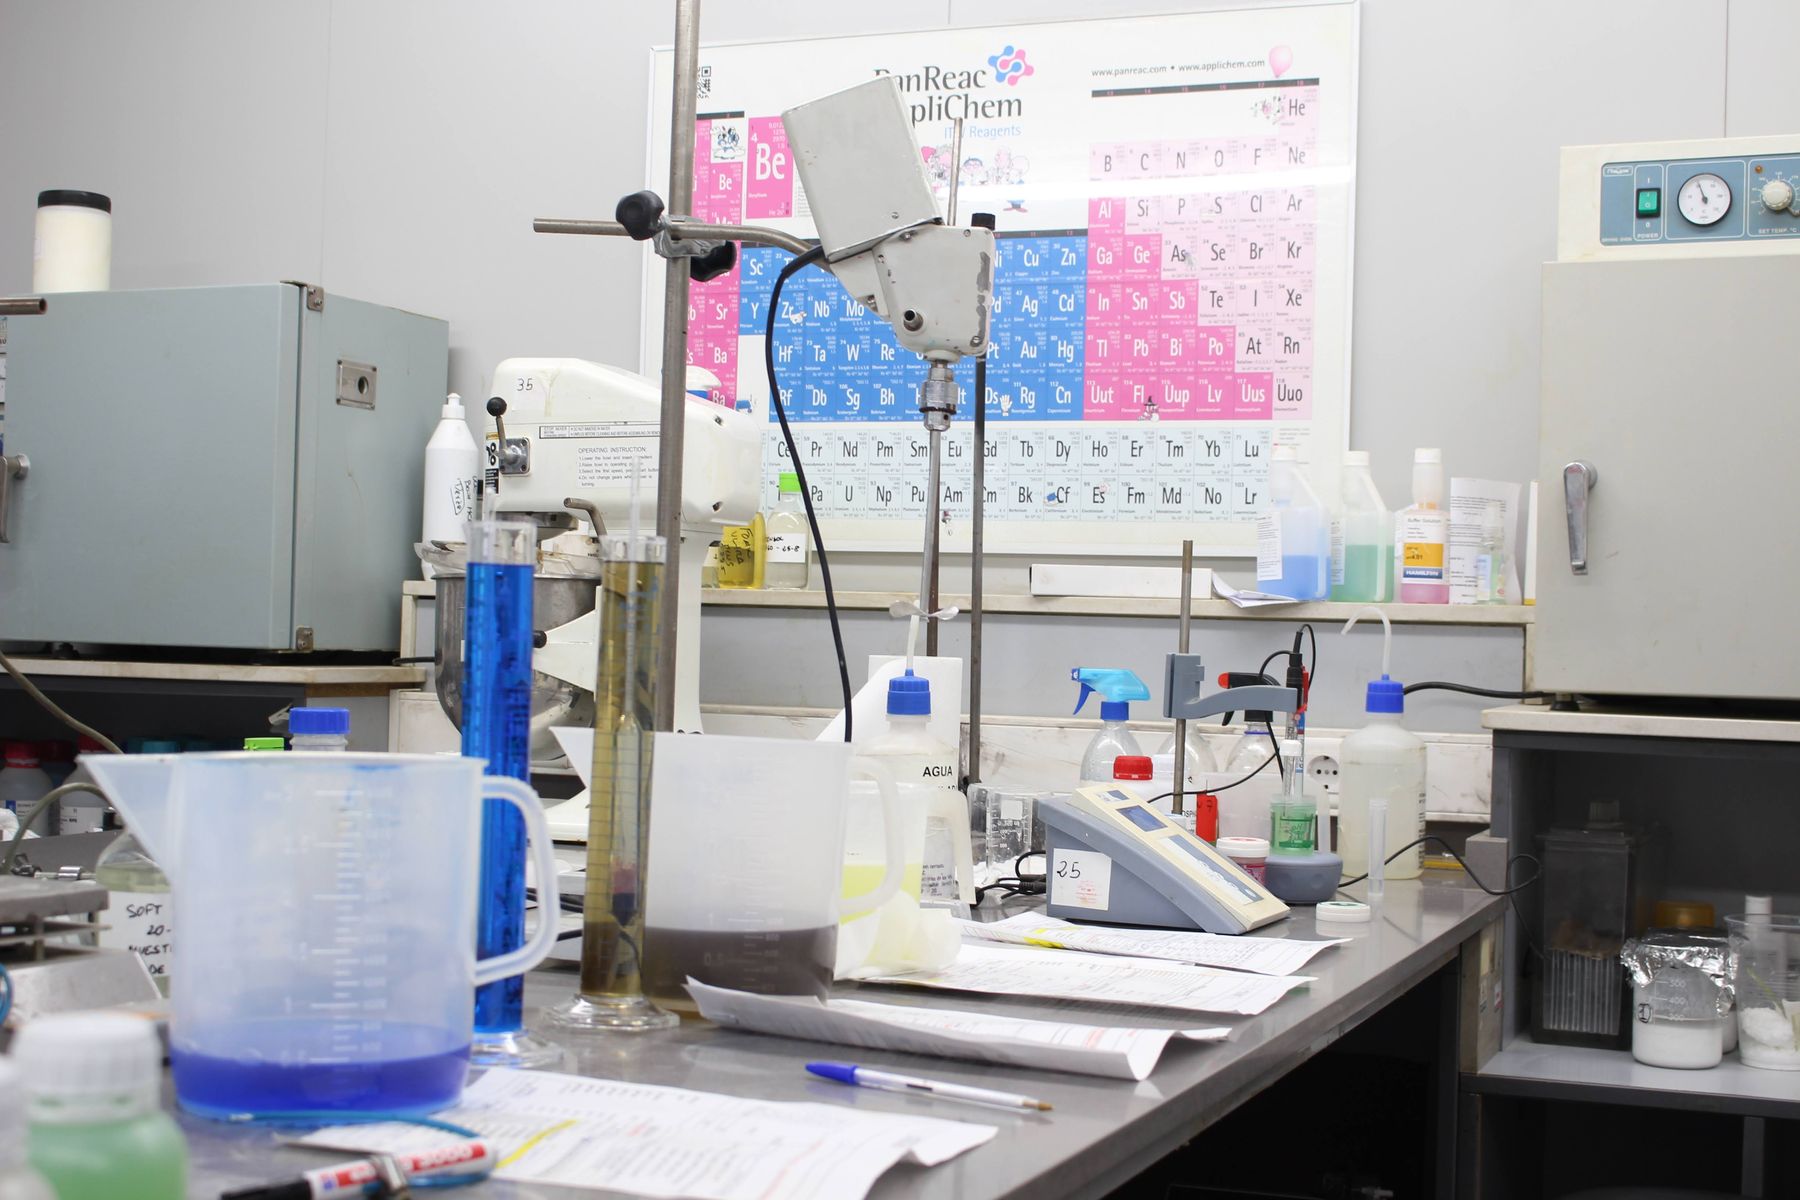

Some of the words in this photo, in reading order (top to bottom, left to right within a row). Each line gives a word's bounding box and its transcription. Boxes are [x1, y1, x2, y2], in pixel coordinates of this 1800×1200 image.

[1091, 65, 1167, 77] www.panreac.com
[1178, 58, 1265, 73] www.applichem.com
[910, 93, 1022, 128] pliChem
[1289, 99, 1305, 116] He
[751, 133, 757, 143] 4
[969, 126, 1022, 140] Reagents
[756, 143, 786, 180] Be
[1104, 154, 1112, 172] B
[1140, 153, 1148, 171] C
[1176, 152, 1186, 169] N
[1215, 150, 1223, 168] O
[1254, 148, 1261, 165] F
[1289, 146, 1305, 164] Ne
[719, 174, 732, 190] Be
[1099, 203, 1111, 218] Al
[1137, 200, 1149, 217] Si
[1178, 198, 1185, 215] P
[1215, 197, 1222, 213] S
[1250, 195, 1262, 213] Cl
[1287, 194, 1302, 212] Ar
[1024, 249, 1039, 267] Cu
[1061, 248, 1076, 265] Zn
[1097, 247, 1112, 265] Ga
[1134, 246, 1150, 264] Ge
[1171, 245, 1186, 262] As
[1211, 243, 1226, 261] Se
[1250, 242, 1263, 259] Br
[1287, 241, 1302, 259] Kr
[750, 258, 763, 276] Sc
[1022, 295, 1038, 317] Ag
[1059, 294, 1074, 312] Cd
[1098, 294, 1109, 311] In
[1132, 292, 1148, 310] Sn
[1169, 291, 1185, 309] Sb
[1210, 291, 1223, 308] Te
[1286, 289, 1302, 307] Xe
[716, 303, 728, 320] Sr
[751, 303, 759, 318] Y
[782, 302, 794, 317] Zr
[814, 301, 830, 317] Nb
[846, 300, 864, 316] Mo
[813, 346, 826, 362] Ta
[847, 345, 860, 360] W
[881, 344, 895, 360] Re
[986, 342, 999, 359] Pt
[1020, 341, 1037, 358] Au
[1058, 340, 1074, 362] Hg
[1097, 340, 1107, 357] Tl
[1134, 339, 1149, 357] Pb
[1170, 339, 1182, 356] Bi
[1209, 338, 1223, 356] Po
[1246, 338, 1262, 355] At
[1284, 337, 1300, 354] Rn
[714, 349, 727, 364] Ba
[779, 346, 793, 363] Hf
[516, 378, 533, 391] 35
[1278, 384, 1303, 401] Uuo
[779, 390, 793, 406] Rf
[813, 390, 827, 406] Db
[846, 389, 860, 410] Sg
[880, 389, 894, 405] Bh
[985, 388, 998, 404] Ds
[1020, 387, 1035, 408] Rg
[1056, 386, 1071, 403] Cn
[1091, 386, 1114, 403] Uut
[1165, 385, 1190, 407] Uup
[1208, 385, 1222, 402] Lv
[1242, 385, 1265, 402] Uus
[778, 441, 790, 457] Ce
[812, 441, 822, 457] Pr
[843, 441, 858, 457] Nd
[877, 441, 893, 457] Pm
[911, 441, 928, 457] Sm
[949, 441, 962, 457] Eu
[1021, 440, 1033, 457] Tb
[1056, 440, 1071, 462] Dy
[1092, 441, 1108, 457] Ho
[1131, 441, 1143, 457] Er
[1166, 440, 1184, 457] Tm
[1205, 440, 1220, 457] Yb
[1245, 440, 1259, 458] Lu
[811, 485, 823, 502] Pa
[845, 486, 853, 502] U
[877, 486, 891, 506] Np
[912, 486, 924, 502] Pu
[944, 486, 962, 502] Am
[1019, 486, 1033, 503] Bk
[1056, 487, 1070, 504] Cf
[1093, 487, 1105, 504] Es
[1128, 487, 1145, 504] Fm
[1162, 487, 1182, 505] Md
[1205, 487, 1222, 505] No
[1245, 488, 1257, 505] Lr
[1405, 569, 1440, 577] HAMILTON
[922, 766, 953, 778] AGUA
[1056, 860, 1081, 879] 25
[126, 903, 163, 918] SOFT
